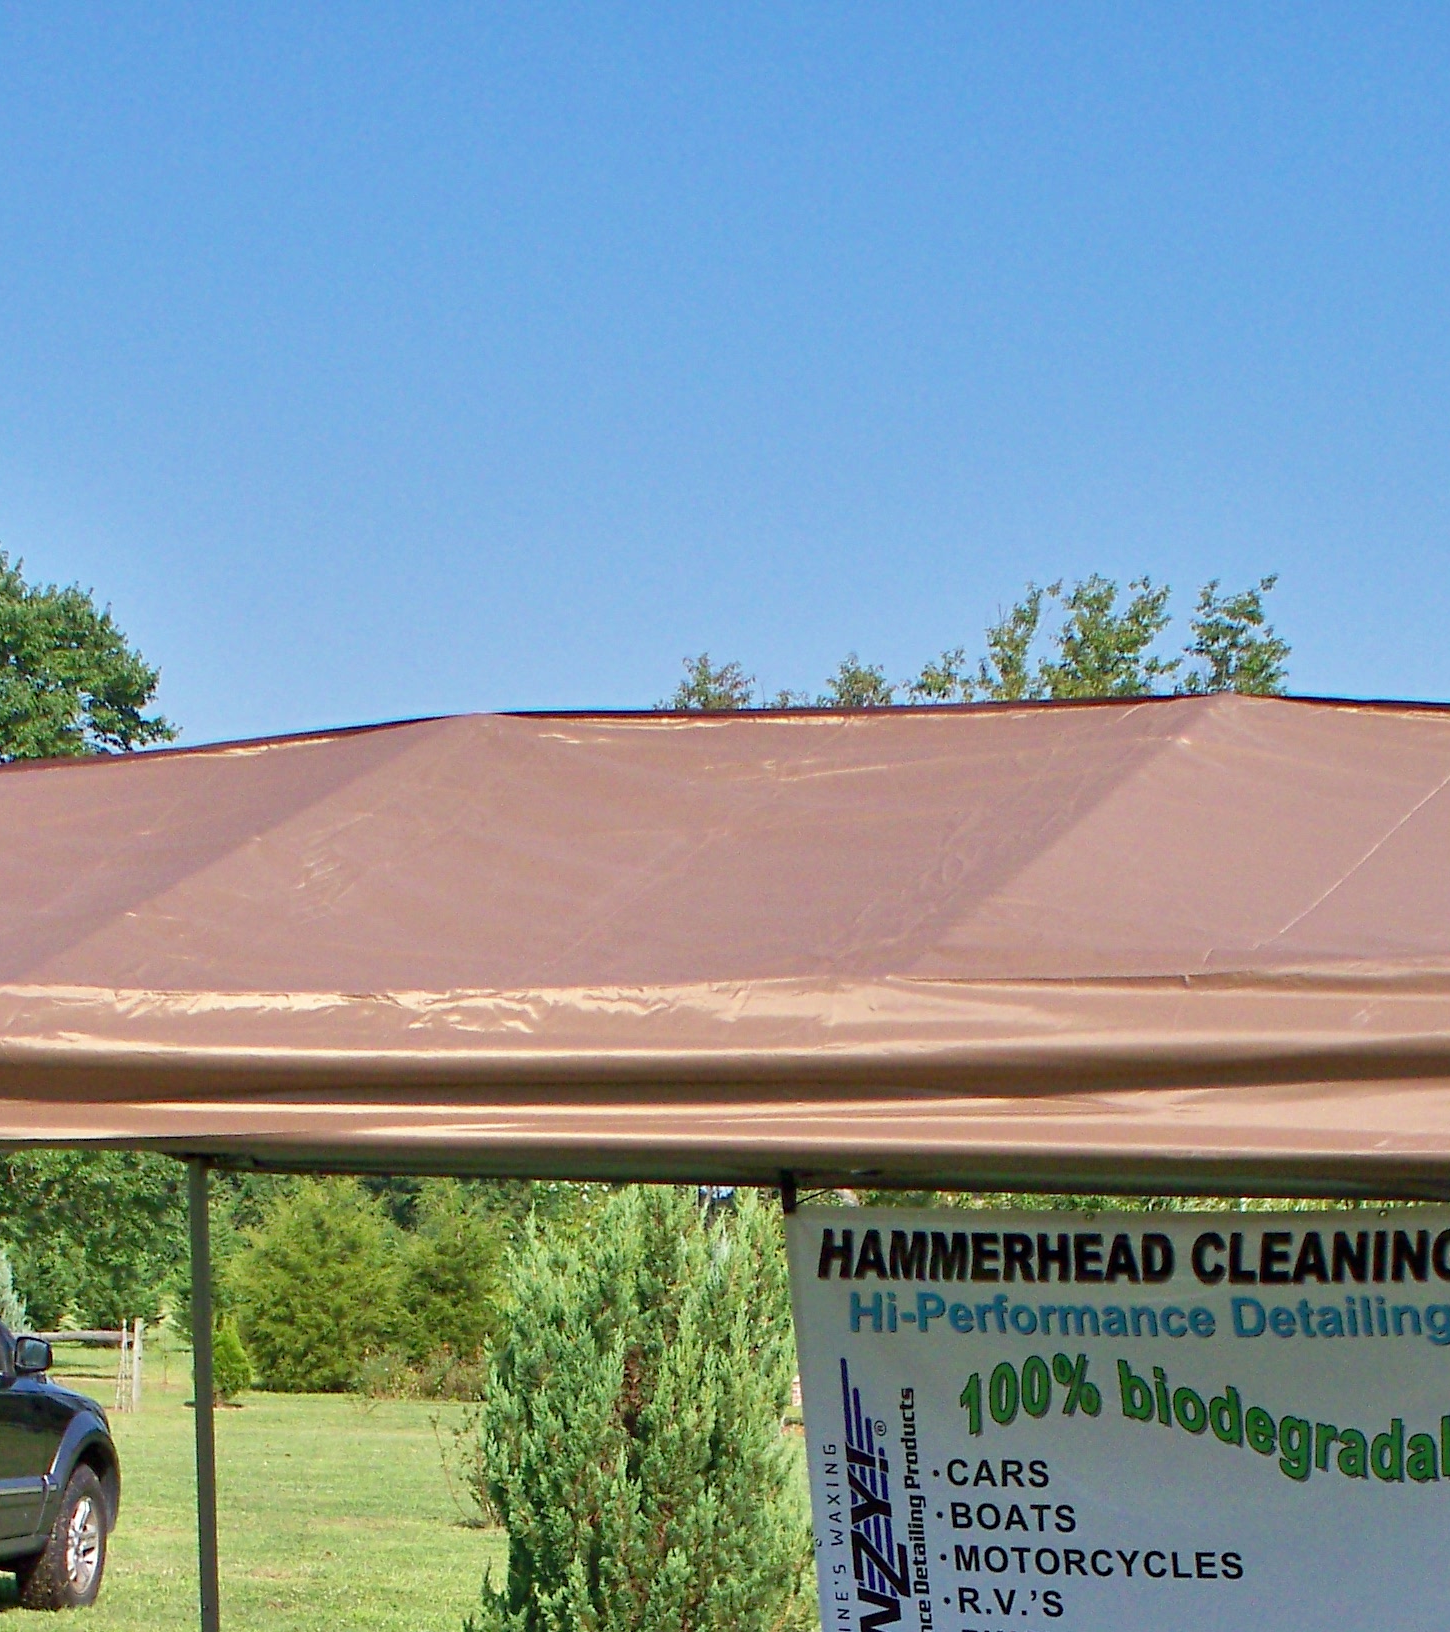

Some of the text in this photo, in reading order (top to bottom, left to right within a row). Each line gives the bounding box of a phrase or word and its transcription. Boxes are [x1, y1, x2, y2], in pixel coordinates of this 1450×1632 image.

[817, 1228, 1176, 1285] HAMMERHEAD
[850, 1291, 1216, 1338] Hi-Performance
[959, 1353, 1102, 1436] 100%
[899, 1387, 920, 1490] Products
[823, 1444, 844, 1547] WAXING
[947, 1458, 1050, 1488] CARS
[950, 1502, 1077, 1533] BOATS
[908, 1494, 930, 1595] Detailing
[954, 1544, 1244, 1580] MOTORCYCLES
[958, 1587, 1064, 1618] R.V.'S
